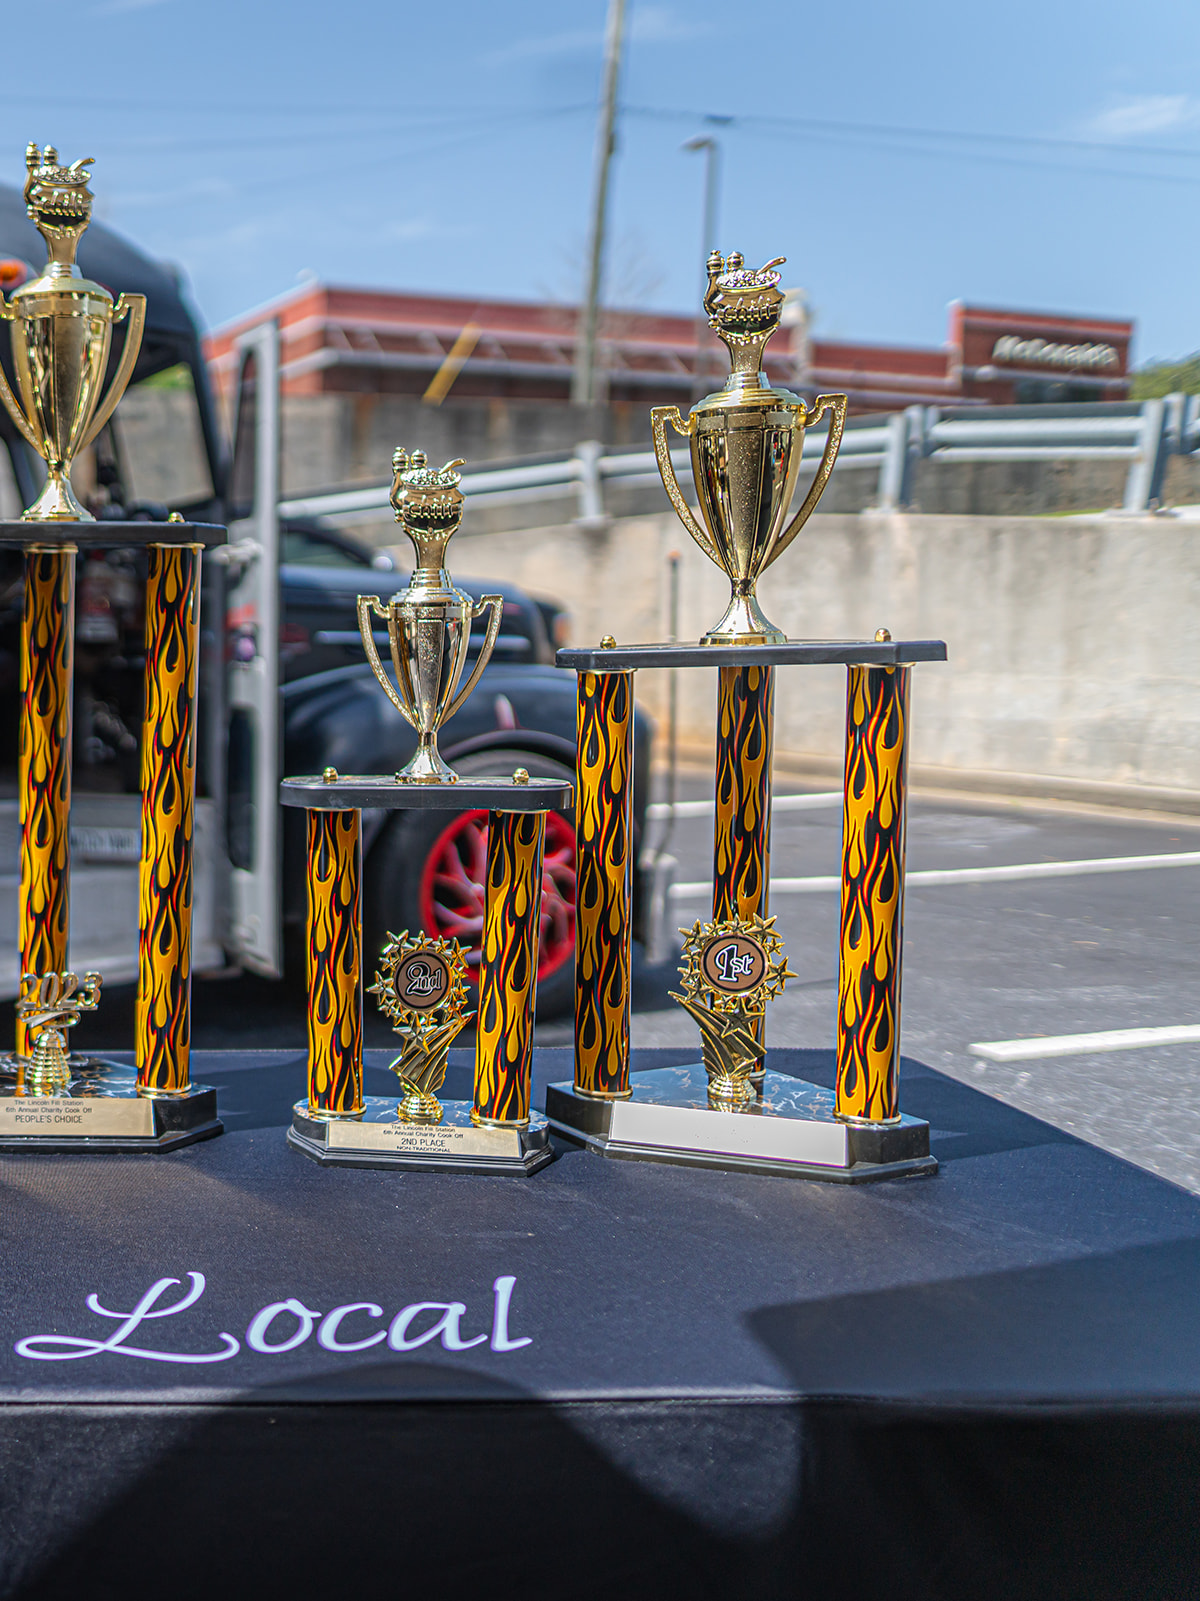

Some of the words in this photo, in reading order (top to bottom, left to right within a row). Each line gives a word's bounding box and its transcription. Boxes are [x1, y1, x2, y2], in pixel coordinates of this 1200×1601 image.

[405, 961, 443, 997] 2nd
[714, 944, 755, 983] 1st
[17, 971, 103, 1010] 2023
[15, 1115, 52, 1123] PEOPLE'S
[54, 1115, 83, 1123] CHOICE
[401, 1137, 417, 1146] 2ND
[420, 1138, 446, 1147] PLACE
[14, 1271, 533, 1363] Local
